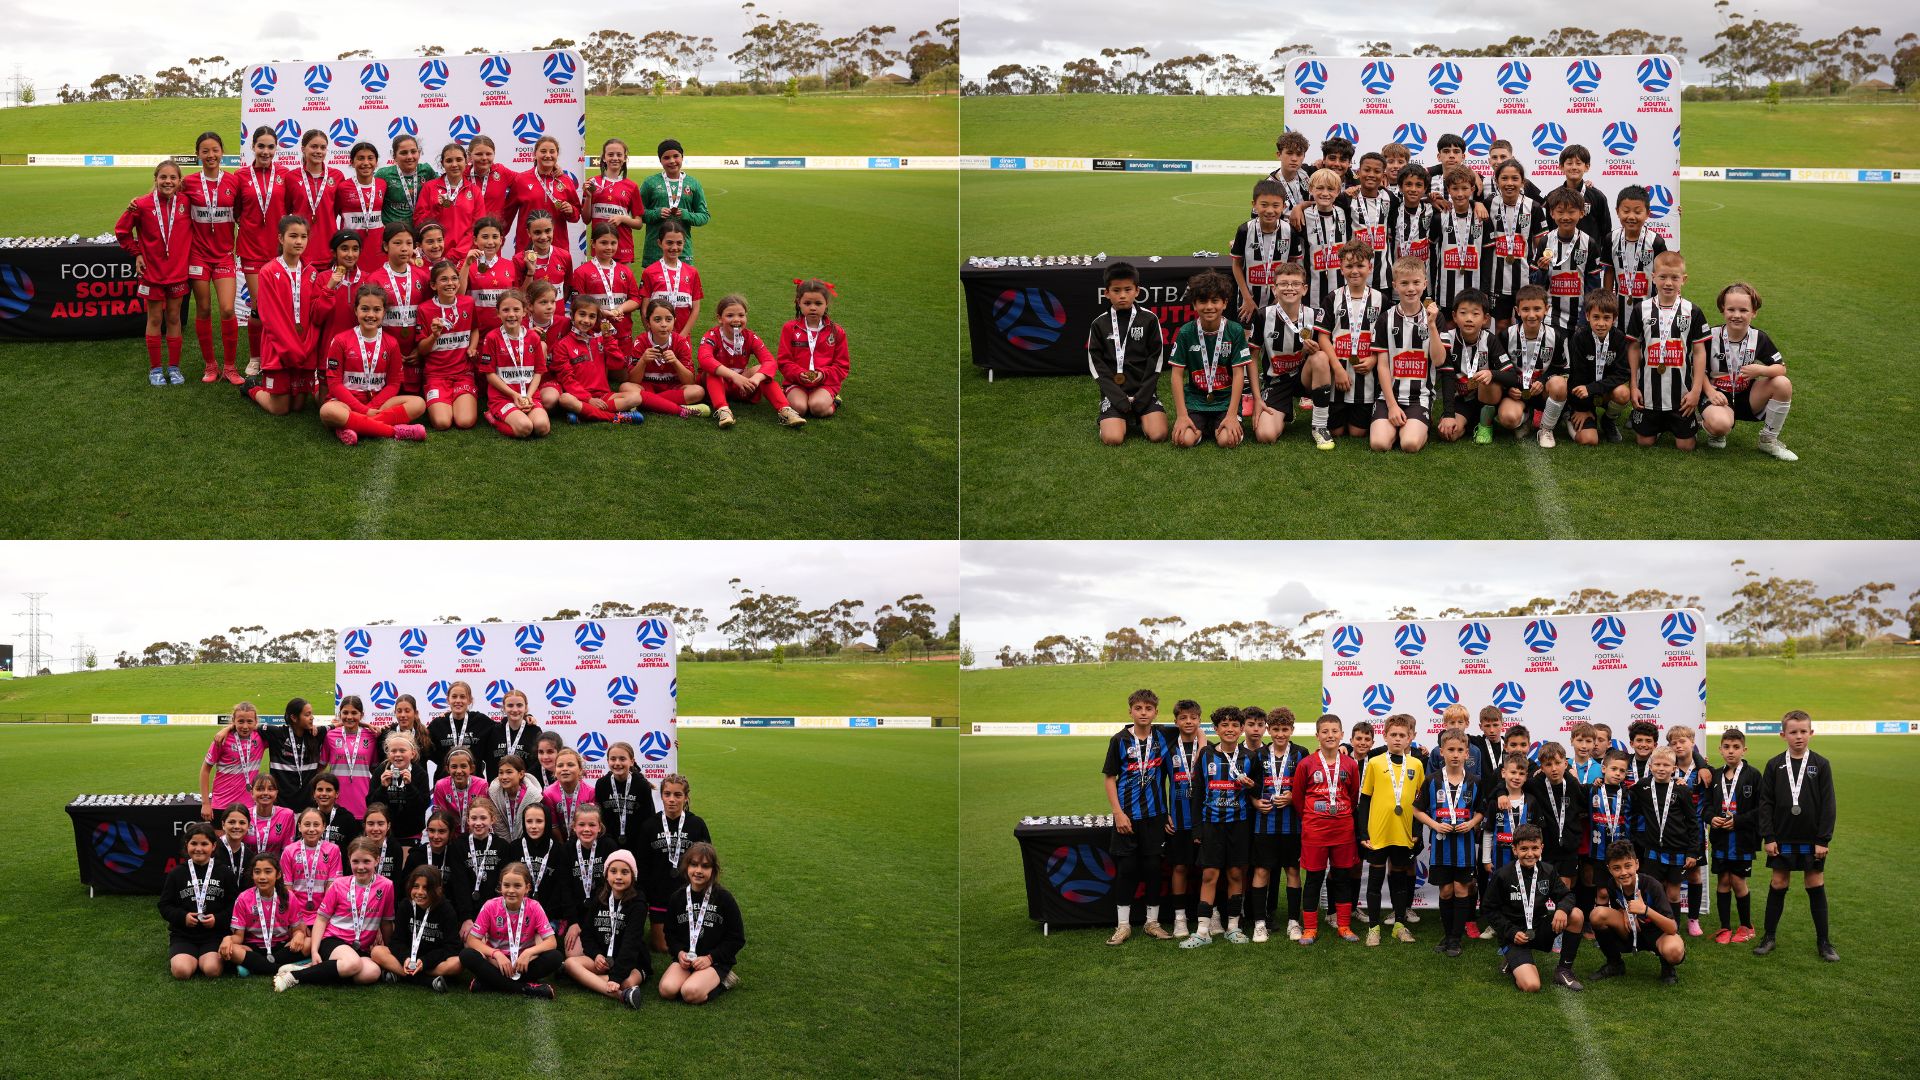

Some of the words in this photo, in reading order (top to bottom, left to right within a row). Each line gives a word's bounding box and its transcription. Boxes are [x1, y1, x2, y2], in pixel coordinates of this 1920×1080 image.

[62, 264, 138, 279] FOOTB
[76, 281, 137, 298] SOUT
[51, 298, 147, 318] AUSTRA
[1337, 340, 1370, 350] CHEIST
